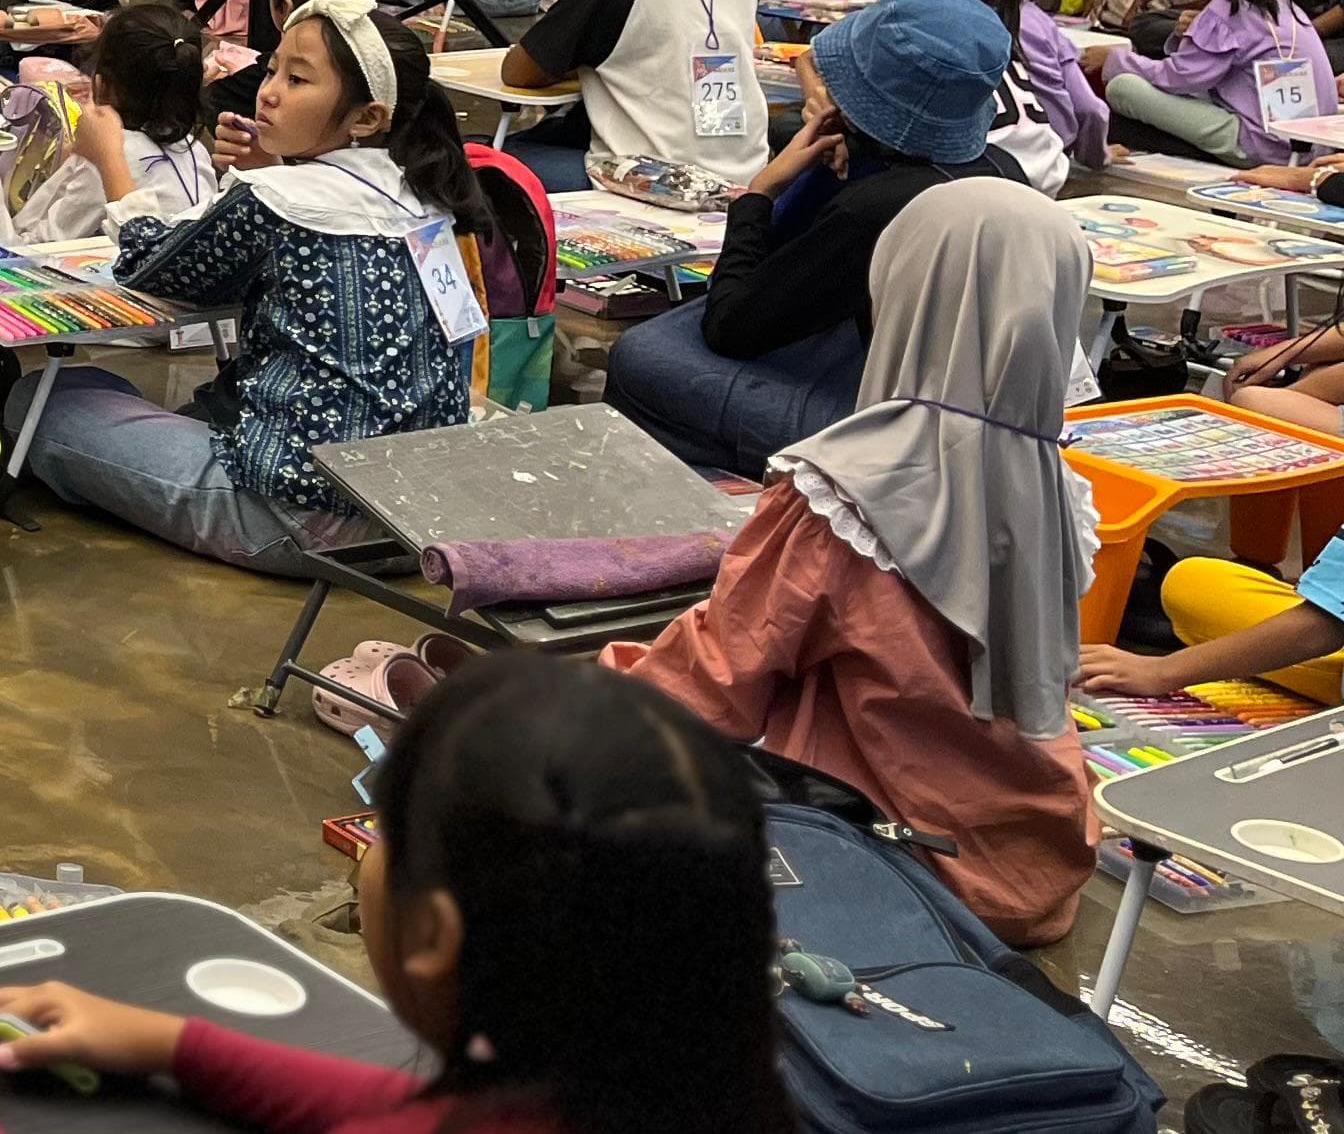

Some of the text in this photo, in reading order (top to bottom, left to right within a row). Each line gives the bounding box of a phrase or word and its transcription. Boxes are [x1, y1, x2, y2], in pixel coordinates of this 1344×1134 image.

[701, 81, 737, 102] 275
[1275, 86, 1302, 105] 15
[431, 264, 457, 294] 34
